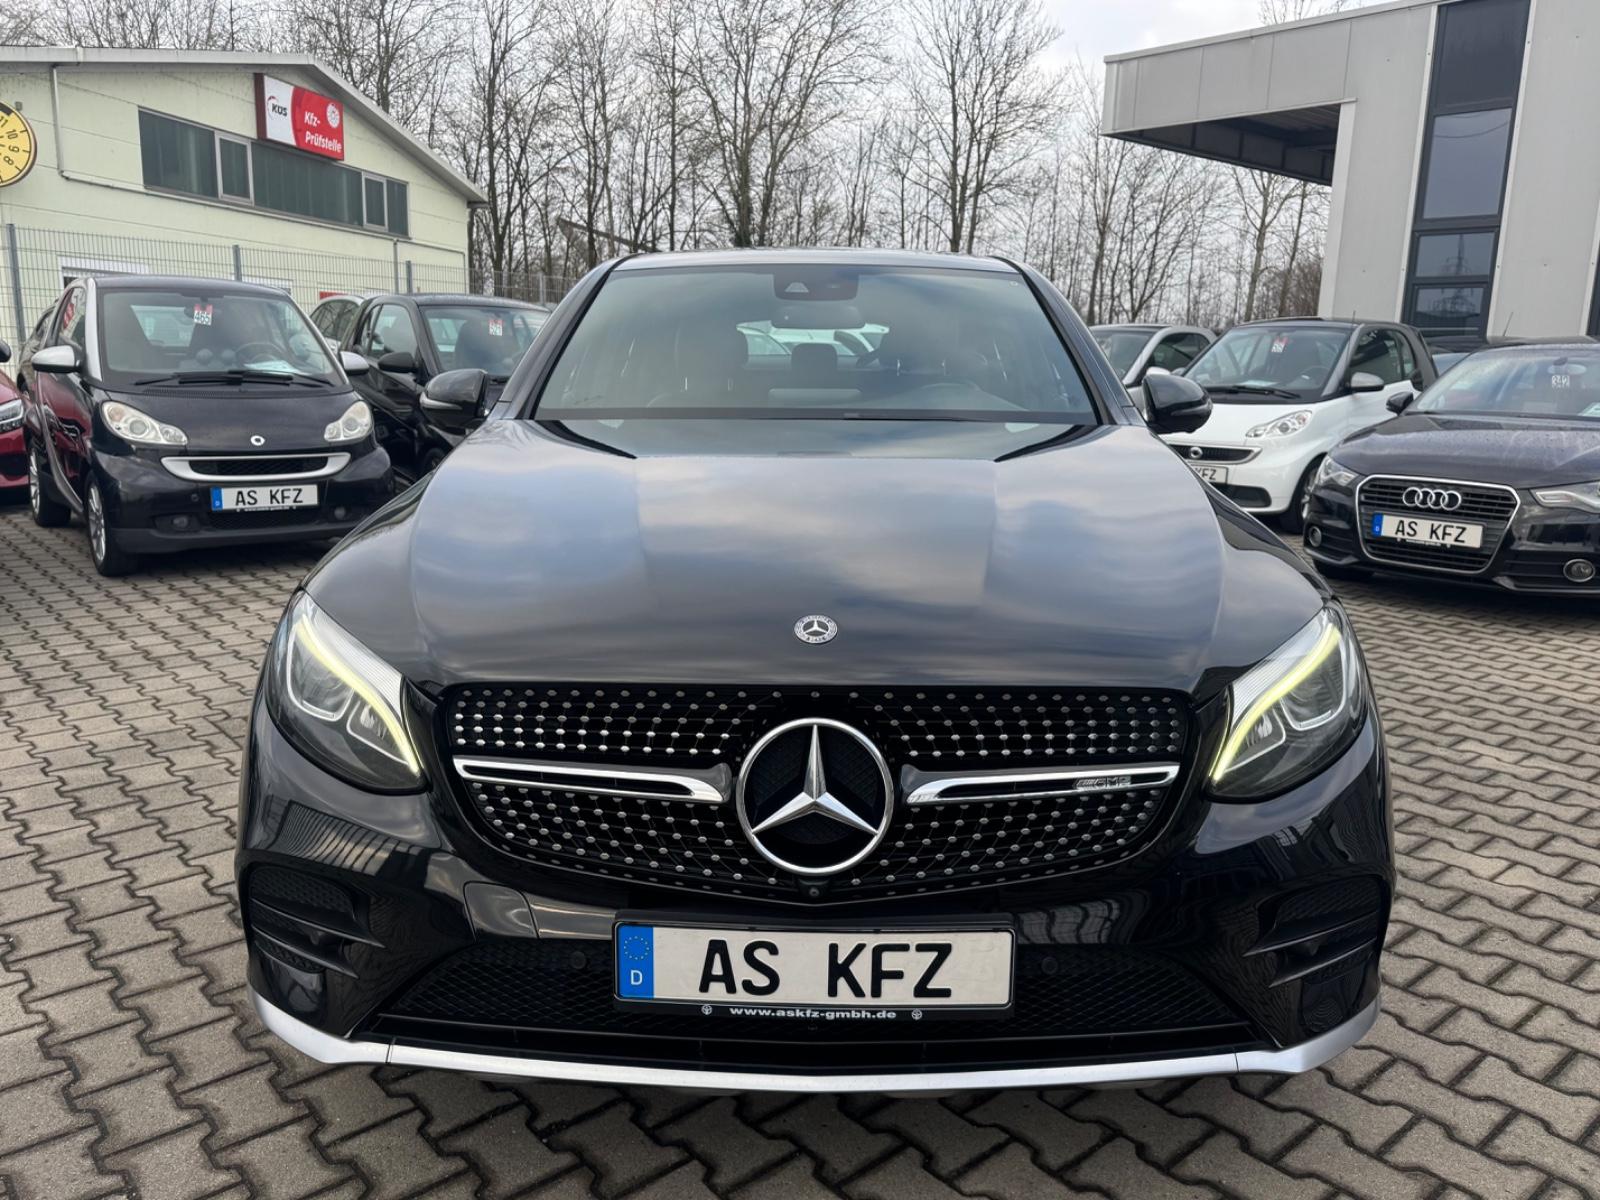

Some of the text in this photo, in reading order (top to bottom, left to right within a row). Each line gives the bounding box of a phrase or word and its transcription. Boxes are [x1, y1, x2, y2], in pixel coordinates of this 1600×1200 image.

[304, 111, 321, 128] Kfz-
[6, 129, 19, 140] 10
[305, 130, 342, 153] Prüfstelle
[8, 144, 20, 153] 9
[3, 155, 14, 166] 8
[235, 490, 258, 506] AS
[269, 488, 303, 505] KFZ
[1395, 519, 1418, 537] AS
[1429, 522, 1467, 543] KFZ
[630, 939, 952, 998] D AS KFZ
[729, 1006, 897, 1020] www.askfz-gmbh.de
